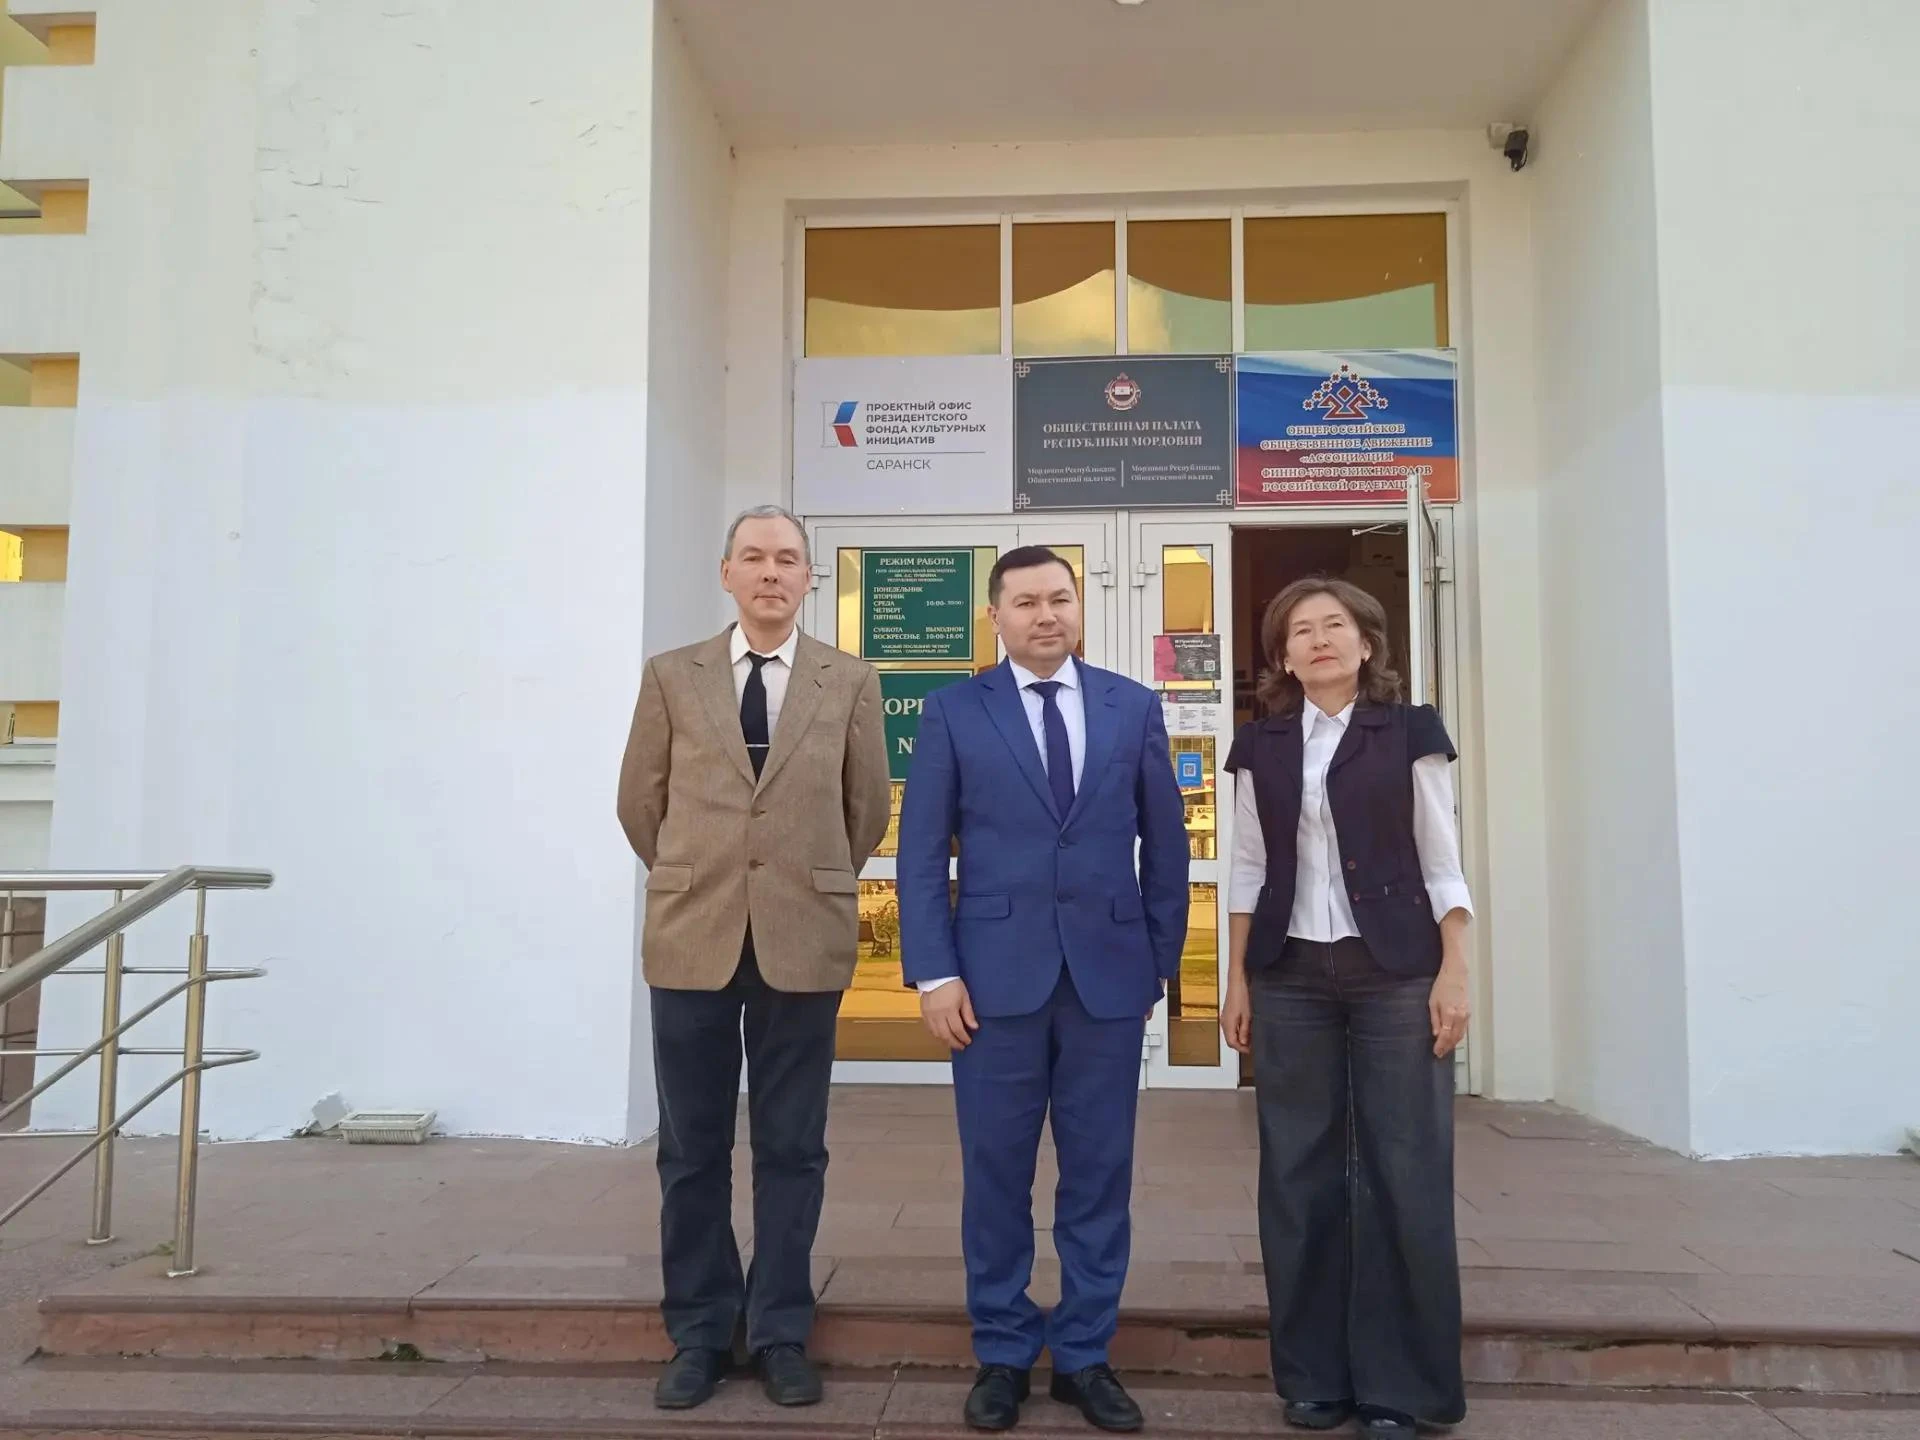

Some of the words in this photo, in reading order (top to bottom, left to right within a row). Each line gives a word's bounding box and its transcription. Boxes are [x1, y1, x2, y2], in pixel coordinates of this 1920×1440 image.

[866, 401, 935, 411] ПРОЕКТНЫЙ
[938, 402, 972, 410] ОФИС
[866, 413, 968, 423] ПРЕЗИДЕНТСКОГО
[866, 425, 908, 435] ФОНДА
[911, 424, 986, 433] КУЛЬТУРНЫХ
[1043, 421, 1149, 434] ОБЩЕСТВЕННАЯ
[1152, 420, 1202, 432] ПАЛАТА
[1287, 423, 1405, 436] ОБЩЕРОССИЙСКОЕ
[866, 436, 935, 446] ИНИЦИАТИВ
[1043, 437, 1129, 449] РЕСПУБЛИКИ
[1131, 436, 1202, 448] МОРДОВИЯ
[1261, 439, 1360, 451] ОБЩЕСТВЕННОЕ
[1361, 437, 1432, 450] ДВИЖЕНИЕ
[1300, 452, 1393, 464] «АССОЦИАЦИЯ
[866, 459, 932, 470] САРАНСК
[1262, 466, 1373, 478] ФИННО-УГОРСКИХ
[1374, 465, 1432, 476] НАРОДОВ
[1262, 479, 1349, 492] РОССИЙСКОЙ
[880, 557, 914, 566] РЕЖИМ
[917, 557, 954, 566] РАБОТЫ
